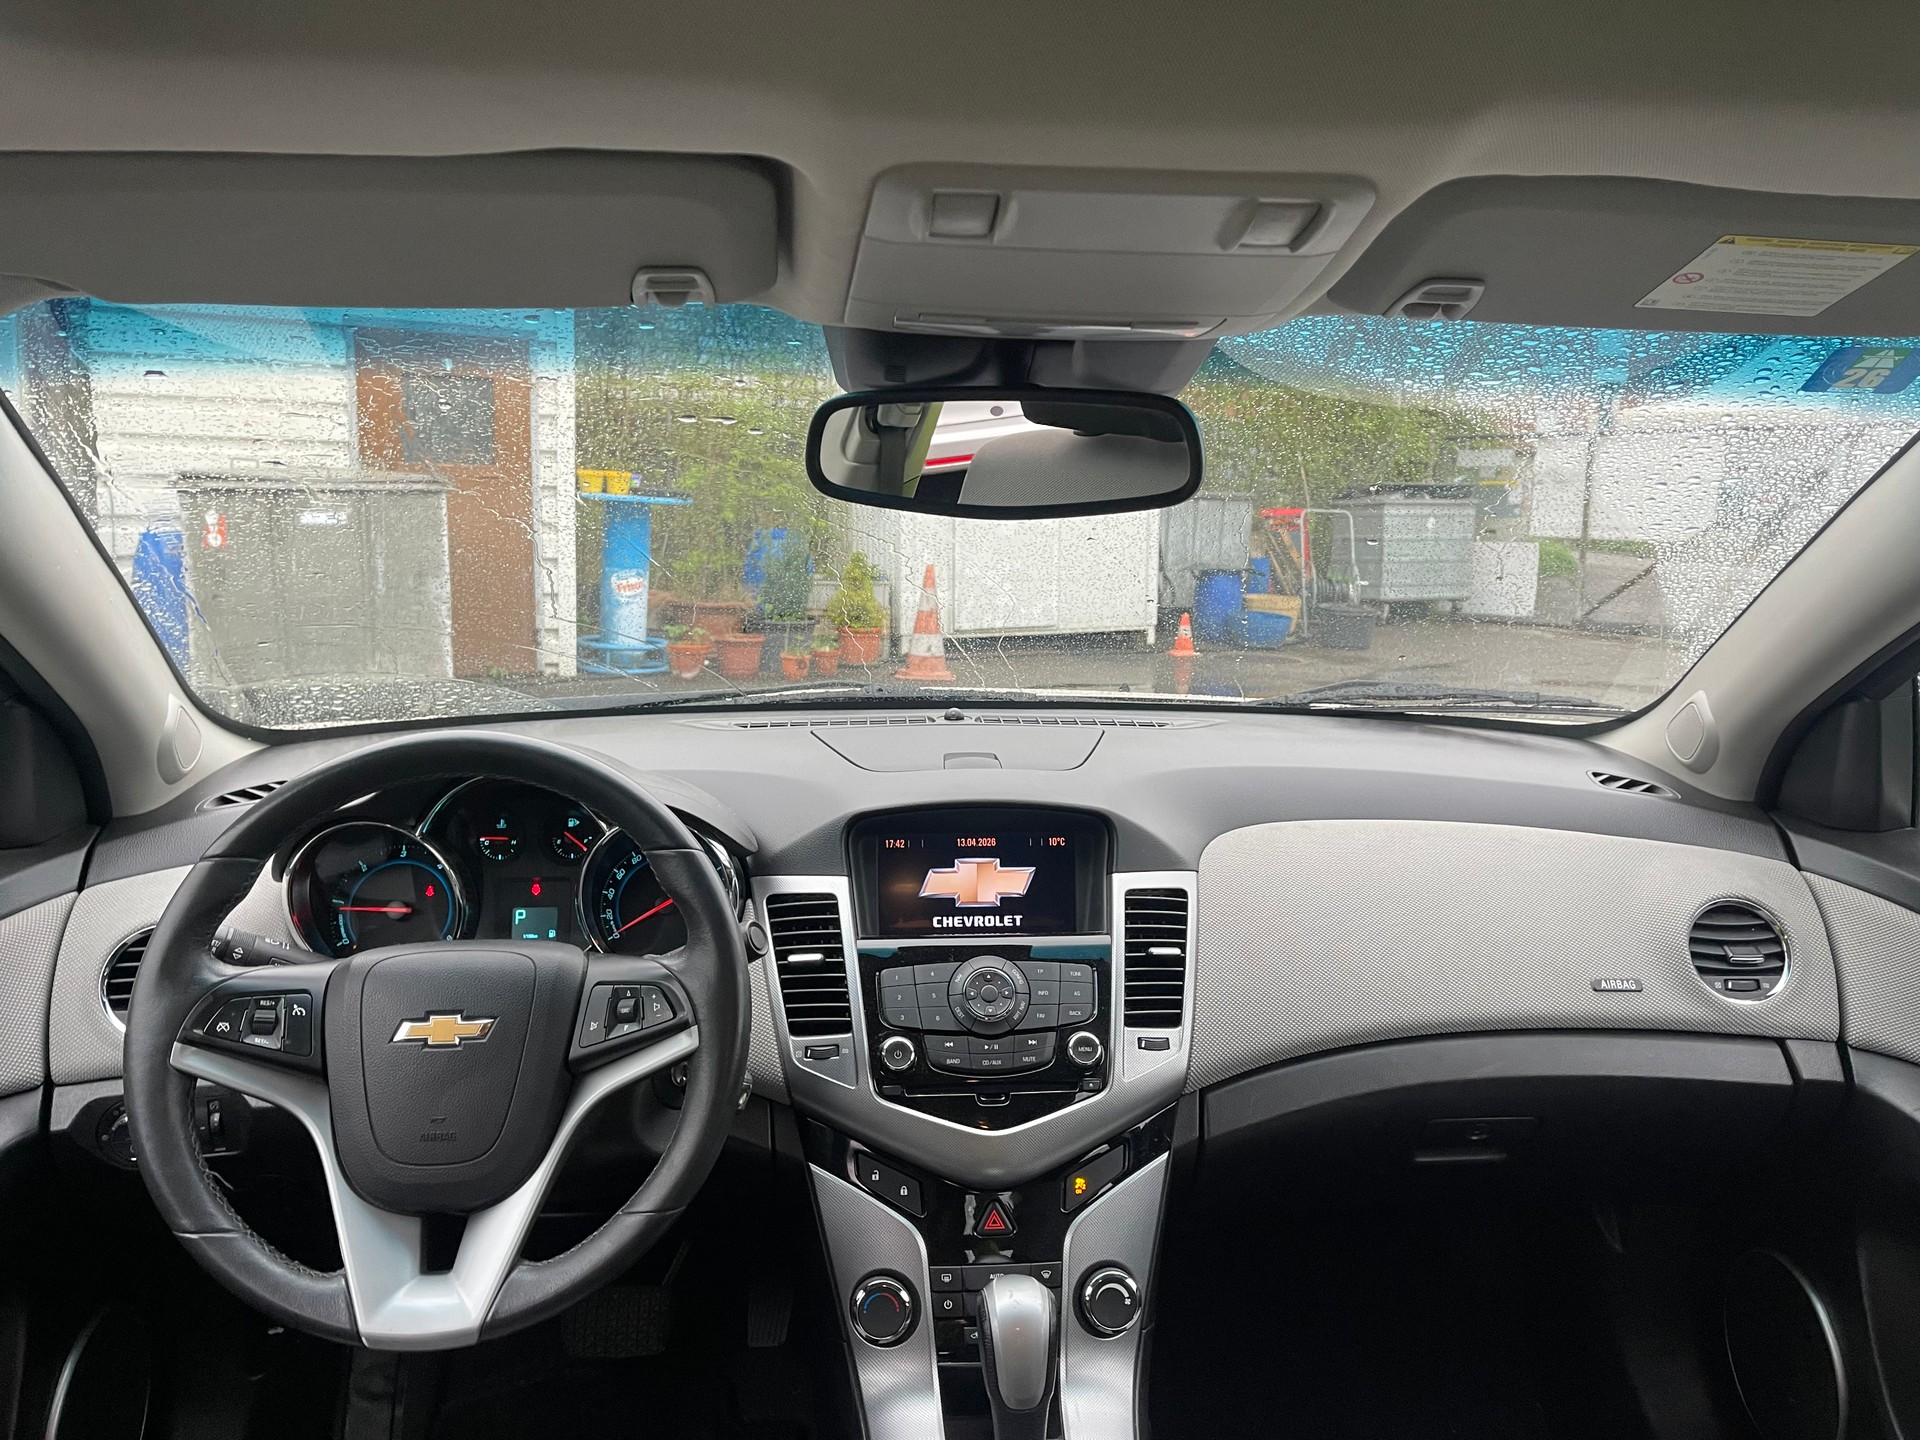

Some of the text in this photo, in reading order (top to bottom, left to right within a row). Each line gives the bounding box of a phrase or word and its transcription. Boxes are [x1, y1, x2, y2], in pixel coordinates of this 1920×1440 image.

[1832, 368, 1891, 388] 26
[885, 839, 905, 849] 17:42
[956, 837, 997, 847] 13.04.2026
[1048, 837, 1066, 846] 10°C
[631, 854, 643, 865] 80
[616, 868, 626, 880] 60
[607, 887, 616, 900] 40
[515, 909, 526, 925] P
[605, 908, 614, 920] 20
[932, 915, 1023, 928] CHEVROLET
[954, 972, 963, 983] NAV
[1011, 968, 1024, 985] CONFIG
[1601, 979, 1636, 990] AIRBAG
[954, 1006, 965, 1019] DEST
[420, 1131, 457, 1142] AIRBAG
